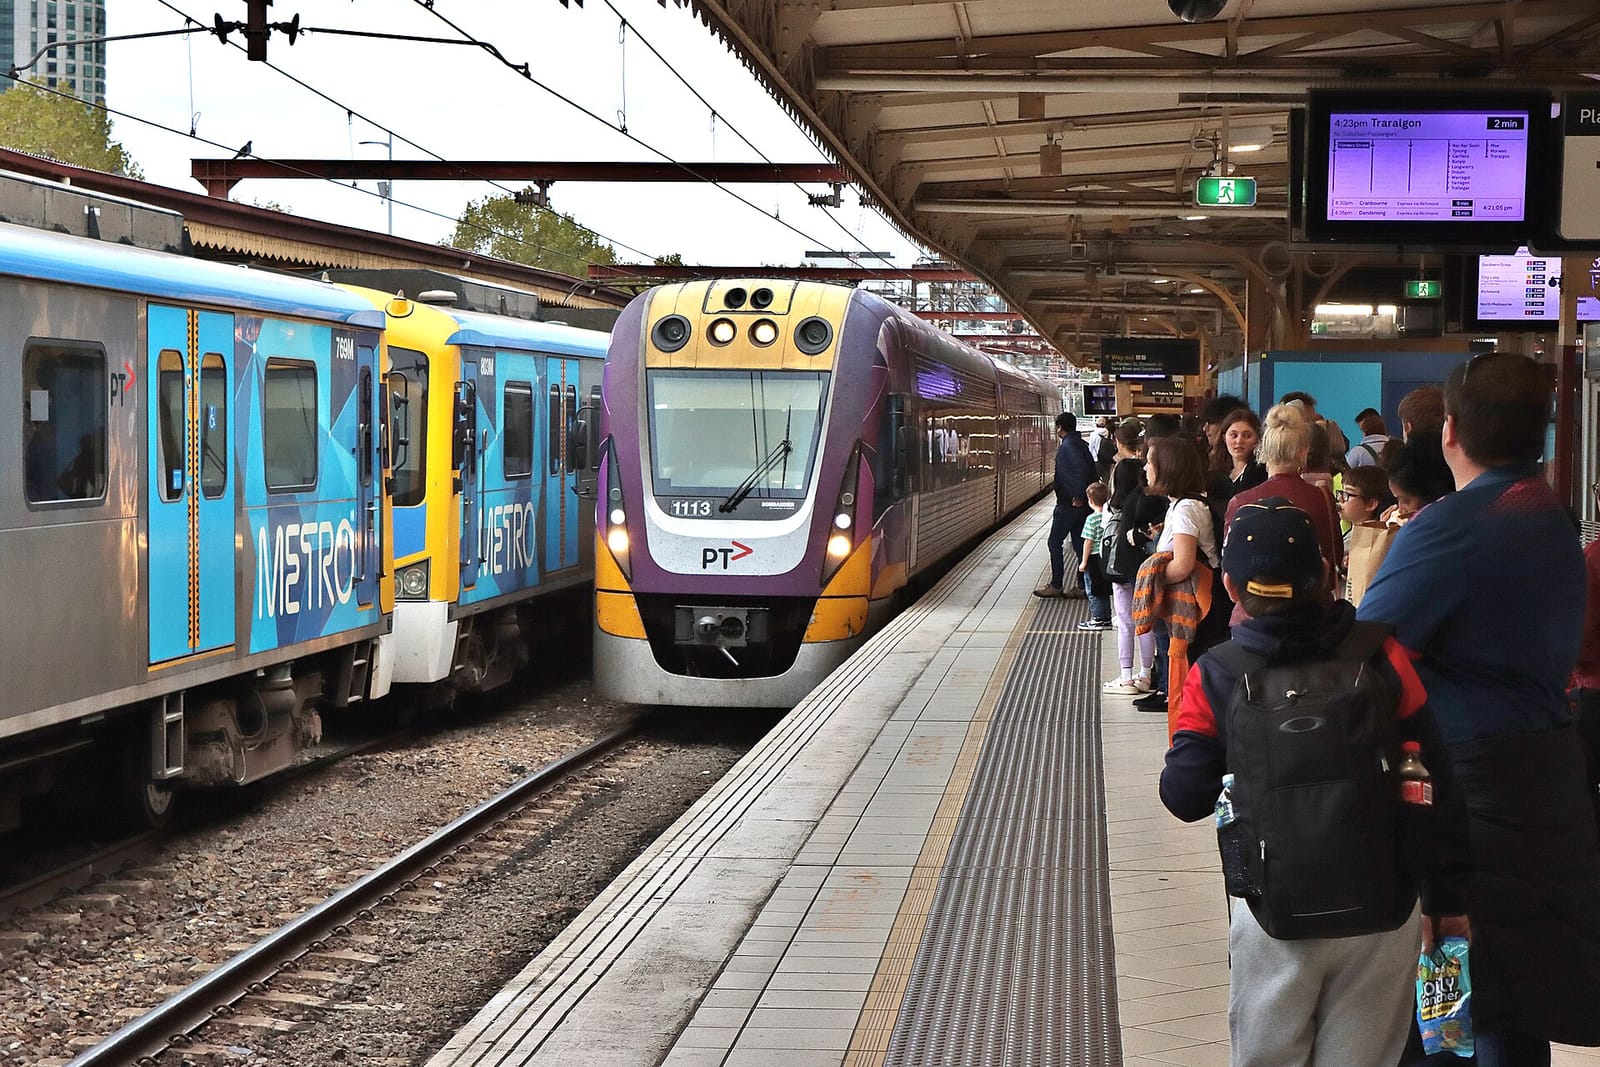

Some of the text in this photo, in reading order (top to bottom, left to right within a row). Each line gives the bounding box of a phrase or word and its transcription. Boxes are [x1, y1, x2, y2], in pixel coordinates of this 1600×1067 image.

[1334, 118, 1422, 130] 4:23pm Traralgon
[1494, 119, 1518, 128] 2 min
[335, 336, 354, 361] 769M
[673, 501, 711, 515] 1113
[478, 501, 536, 578] METRO
[258, 518, 355, 620] METRO
